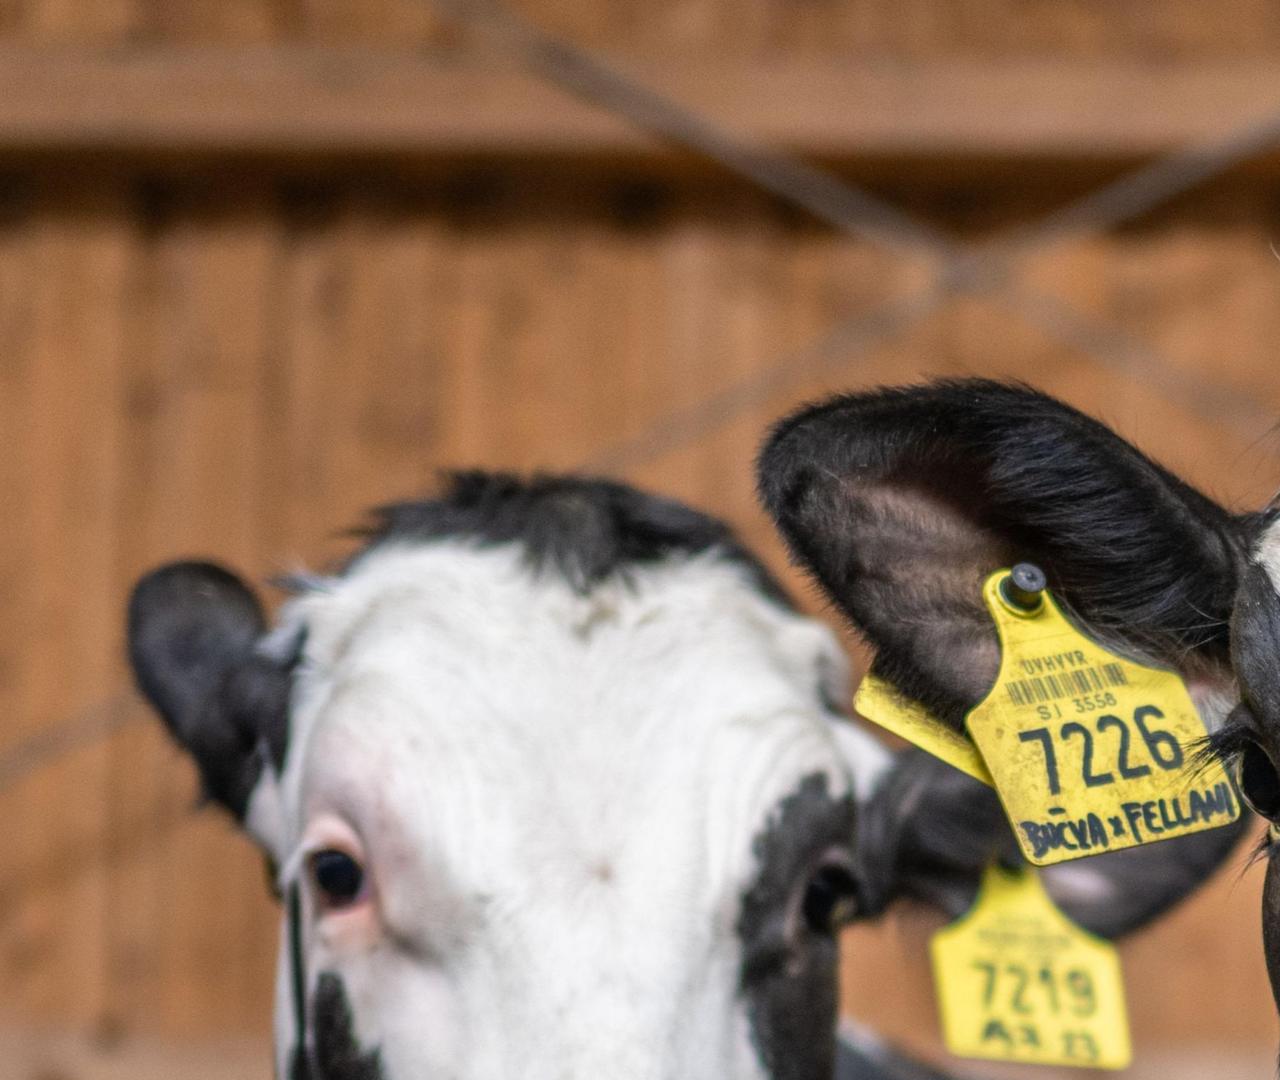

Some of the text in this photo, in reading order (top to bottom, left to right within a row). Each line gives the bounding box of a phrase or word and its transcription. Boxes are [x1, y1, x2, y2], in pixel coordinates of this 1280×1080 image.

[1072, 692, 1117, 713] 3558
[1018, 704, 1184, 796] 7226
[972, 959, 1099, 1017] 7219
